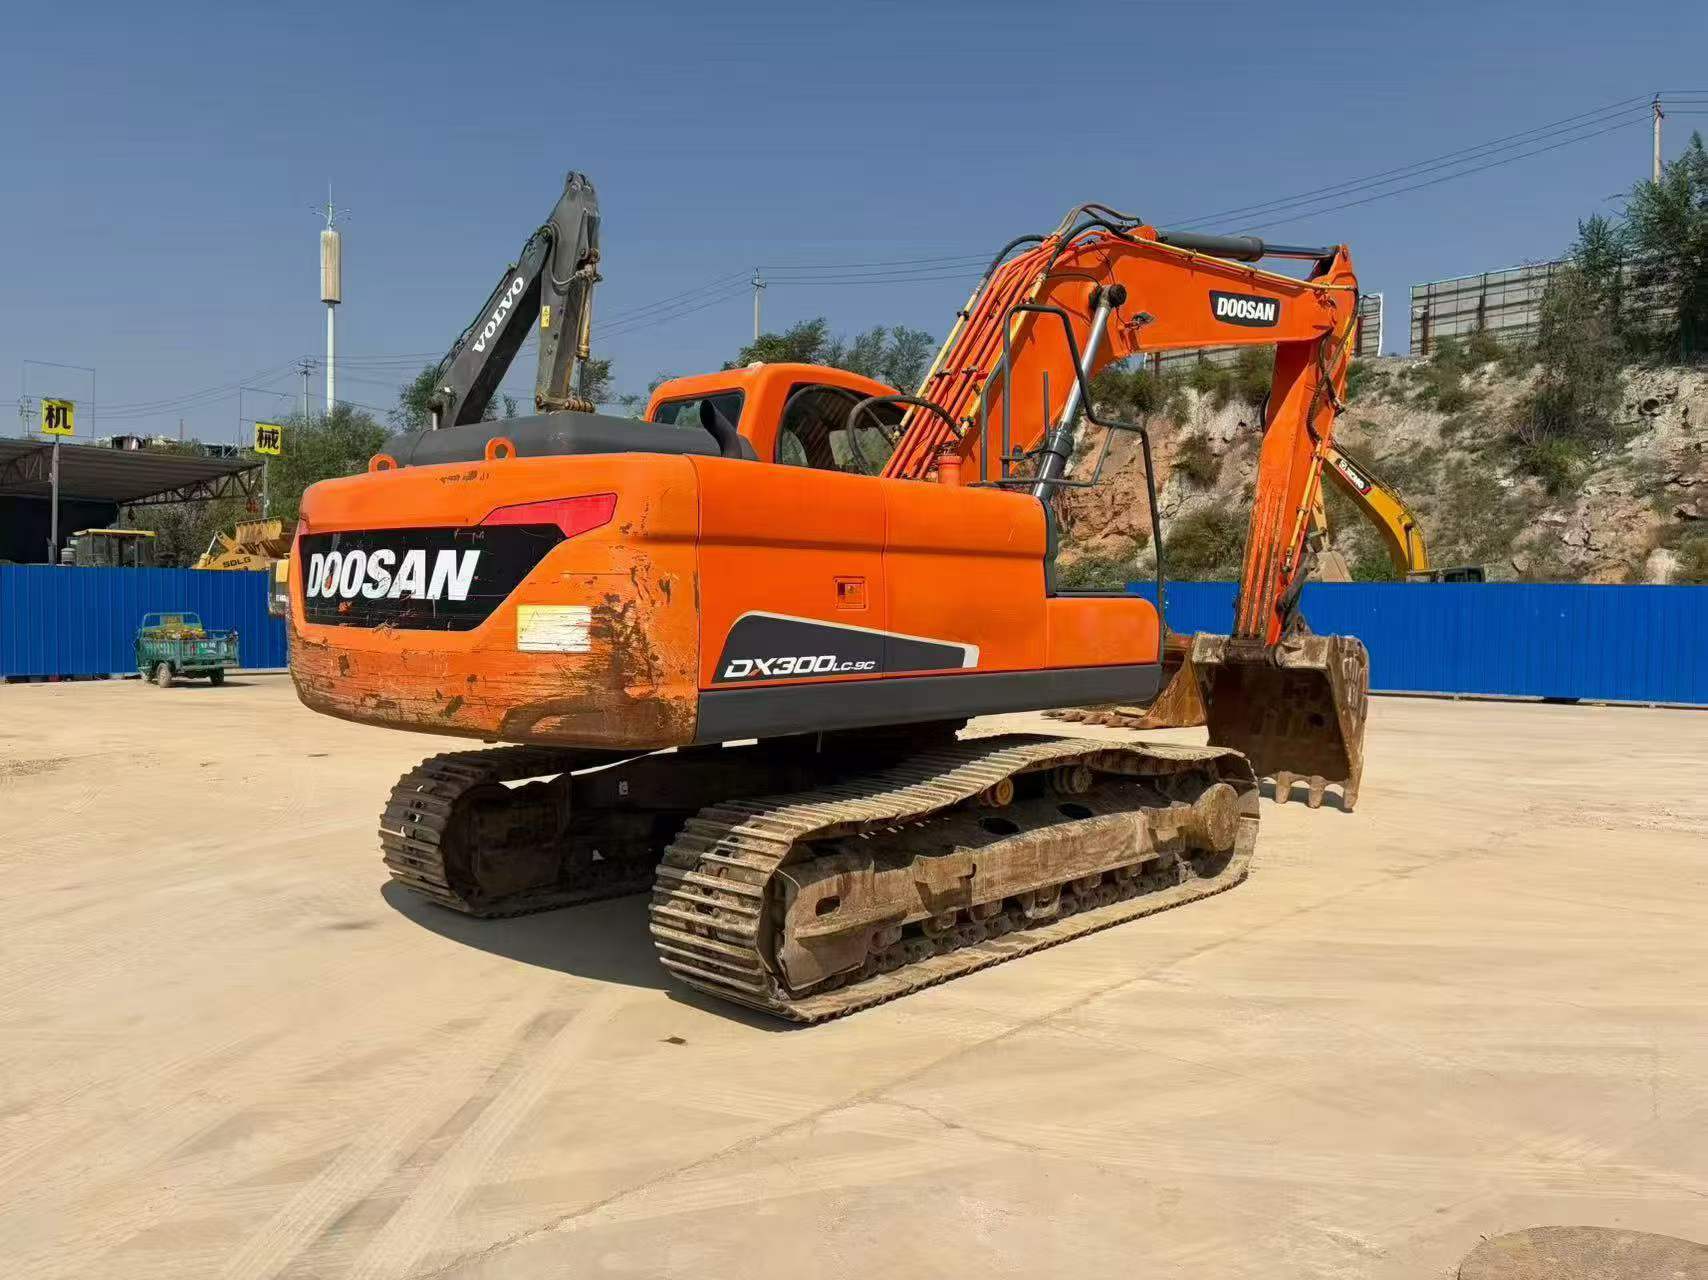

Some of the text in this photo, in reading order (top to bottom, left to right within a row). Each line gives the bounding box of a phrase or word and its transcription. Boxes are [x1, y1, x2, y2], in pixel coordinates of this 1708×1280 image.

[472, 276, 524, 354] VOLVO
[1217, 297, 1275, 321] DOOSAN
[45, 404, 71, 430] 机
[257, 428, 279, 450] 械
[223, 556, 252, 568] SDLG
[306, 549, 481, 601] DOOSAN
